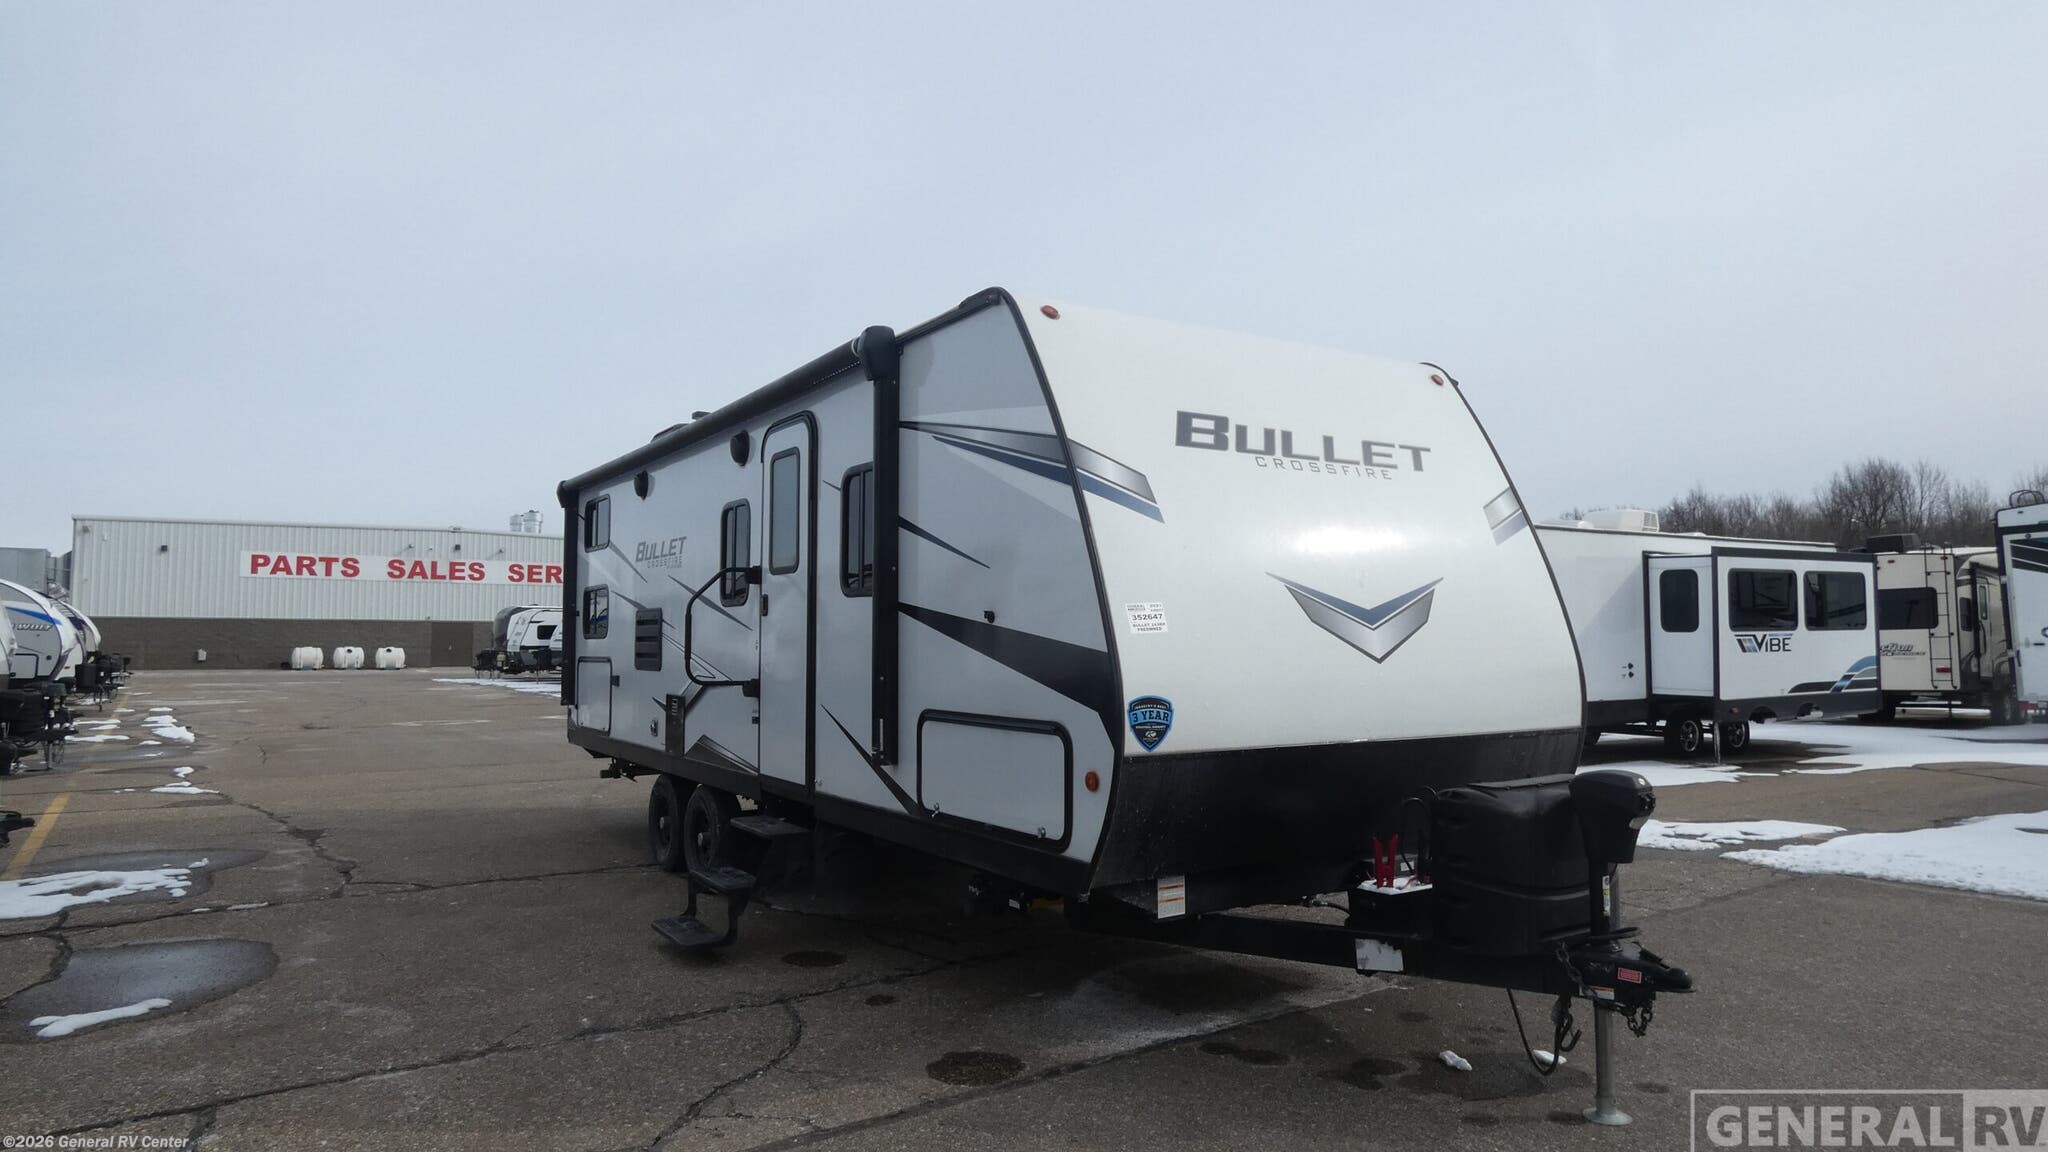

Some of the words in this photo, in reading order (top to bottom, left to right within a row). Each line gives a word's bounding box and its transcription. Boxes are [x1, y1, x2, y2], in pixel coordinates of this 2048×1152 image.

[1175, 410, 1431, 472] BULLET
[1255, 456, 1392, 480] CROSSFIRE
[636, 536, 687, 562] BULLET
[250, 554, 360, 577] PARTS
[387, 559, 486, 581] SALES
[508, 563, 564, 584] SER
[1131, 613, 1163, 621] 352647
[1749, 634, 1792, 652] VIBE
[1131, 712, 1139, 723] 3
[1141, 710, 1170, 722] YEAR
